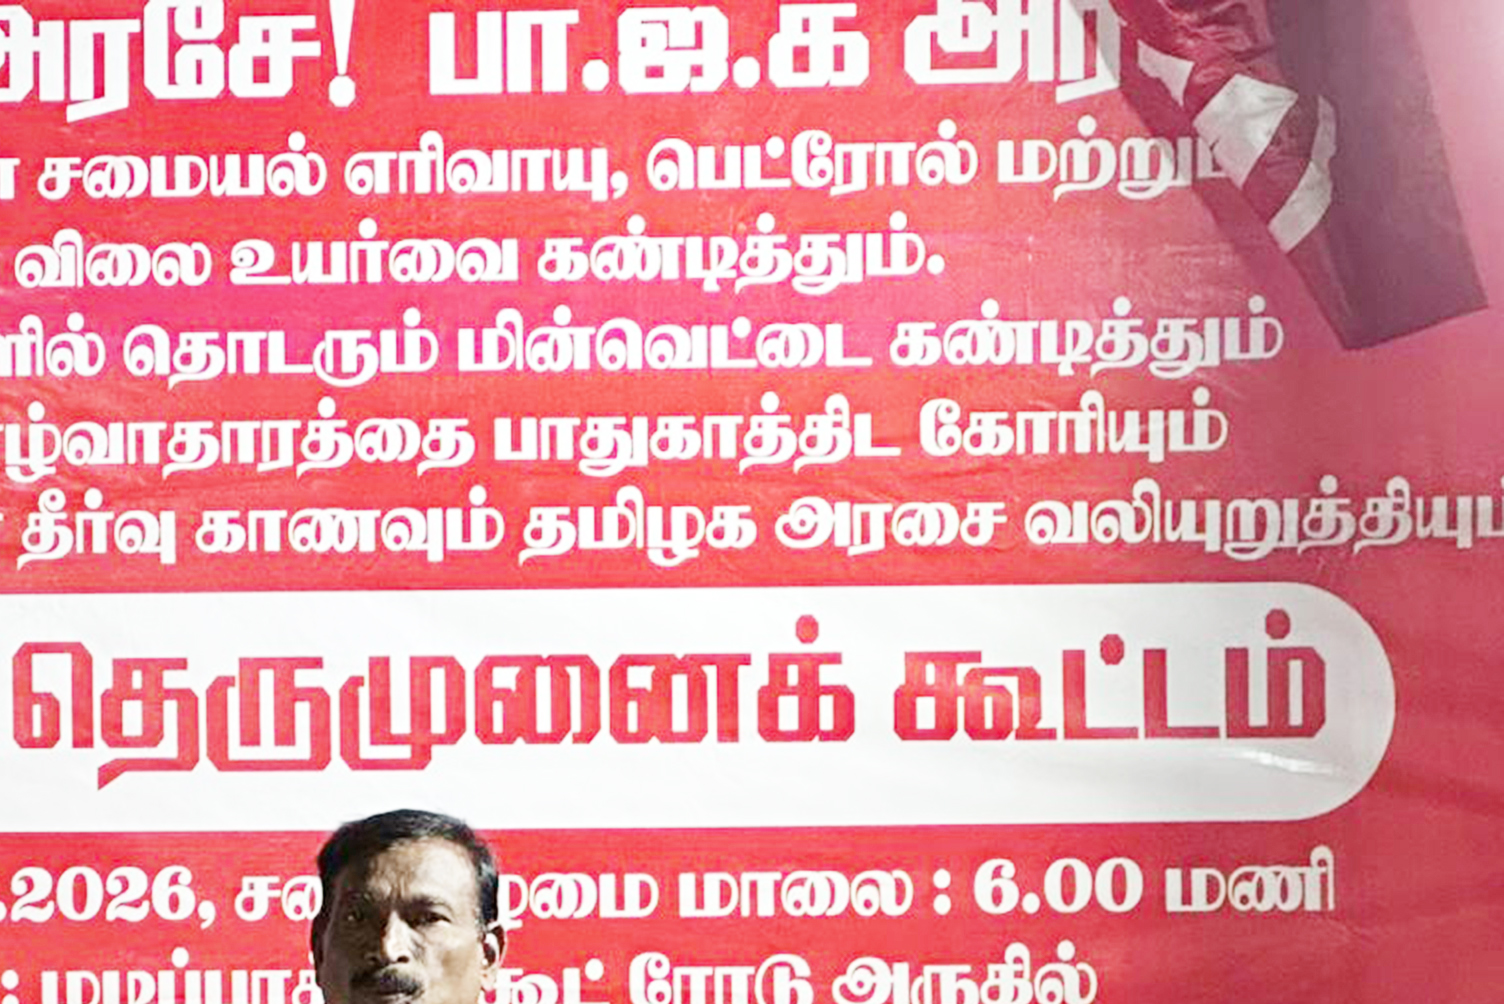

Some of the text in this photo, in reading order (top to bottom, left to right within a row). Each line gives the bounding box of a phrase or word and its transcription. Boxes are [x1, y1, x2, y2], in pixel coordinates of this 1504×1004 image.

[904, 0, 1119, 103] அர
[38, 132, 327, 200] சமையல்
[345, 131, 628, 202] எரிவாயு,
[647, 119, 978, 196] பெட்ரோல்
[15, 229, 212, 288] விலை
[230, 218, 518, 285] உயர்வை
[538, 211, 945, 295] கண்டித்தும்.
[123, 308, 439, 389] தொடரும்
[458, 305, 873, 372] மின்வெட்டை
[890, 296, 1283, 379] கண்டித்தும்
[494, 392, 901, 477] பாதுகாத்திட
[920, 387, 1227, 462] கோரியும்
[17, 488, 176, 570] தீர்வு
[195, 485, 504, 562] காணவும்
[519, 486, 757, 567] தமிழக
[775, 496, 1007, 556] அரசை
[13, 615, 855, 789] தெருமுனைக்
[894, 608, 1326, 740] கூட்டம்
[679, 870, 913, 917] மாலை
[974, 858, 1143, 914] 6.00
[1165, 846, 1334, 912] மணி
